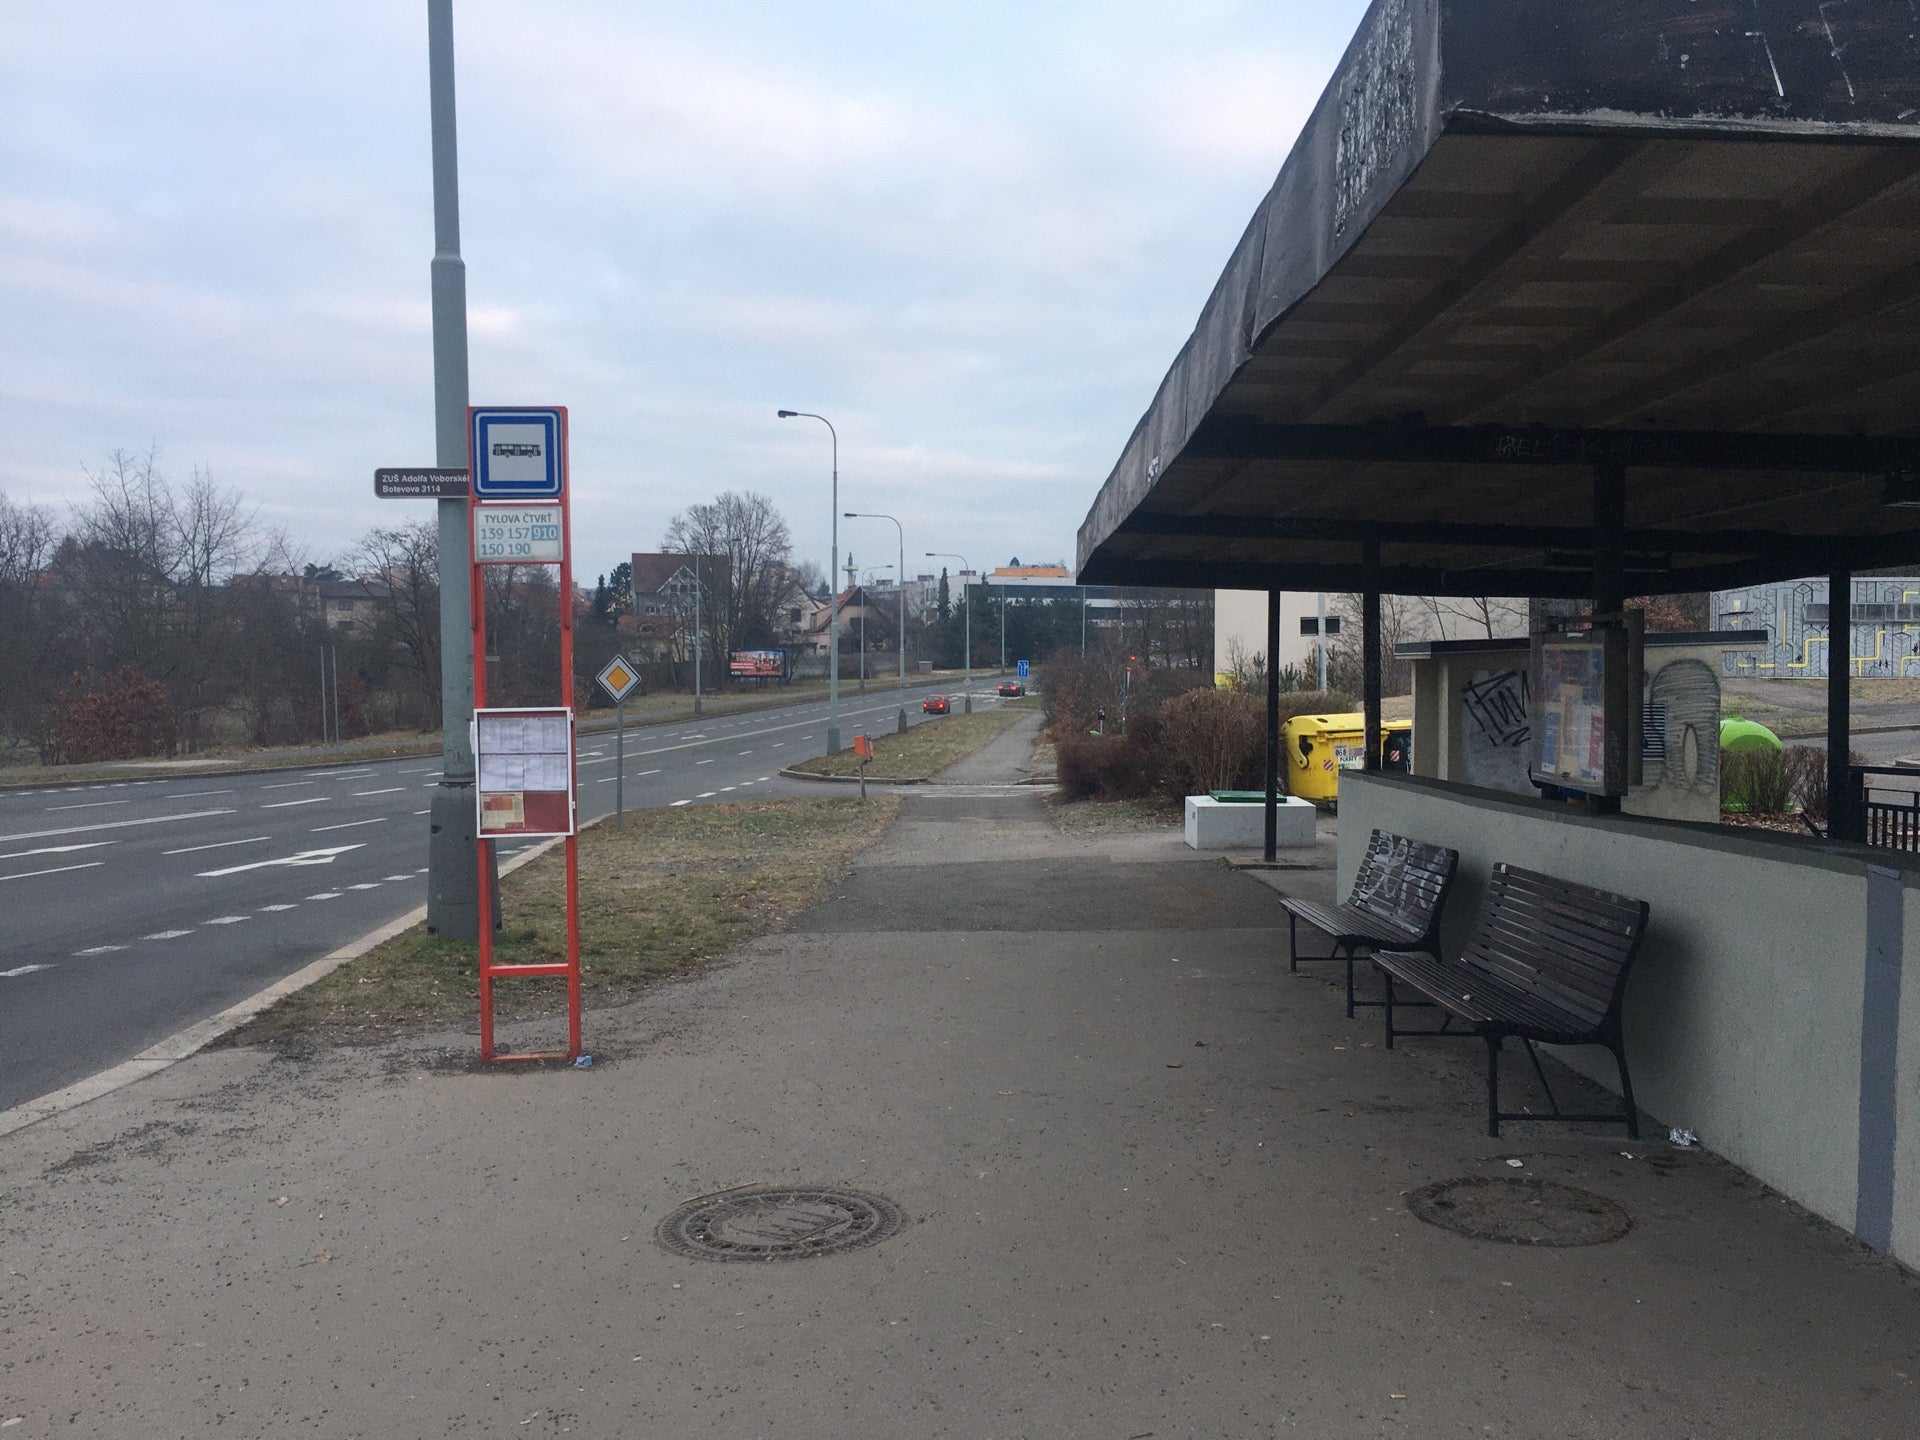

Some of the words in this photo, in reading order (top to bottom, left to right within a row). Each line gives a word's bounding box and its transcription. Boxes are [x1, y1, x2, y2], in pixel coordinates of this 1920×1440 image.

[382, 474, 400, 483] ZUŠ
[401, 475, 428, 483] Adolfa
[382, 485, 420, 493] Botevova
[484, 515, 521, 524] TYLOVA
[522, 512, 553, 524] ČTVRŤ
[480, 527, 504, 540] 139
[507, 527, 531, 540] 157
[533, 526, 557, 539] 910
[481, 543, 504, 556] 150
[508, 543, 531, 556] 190
